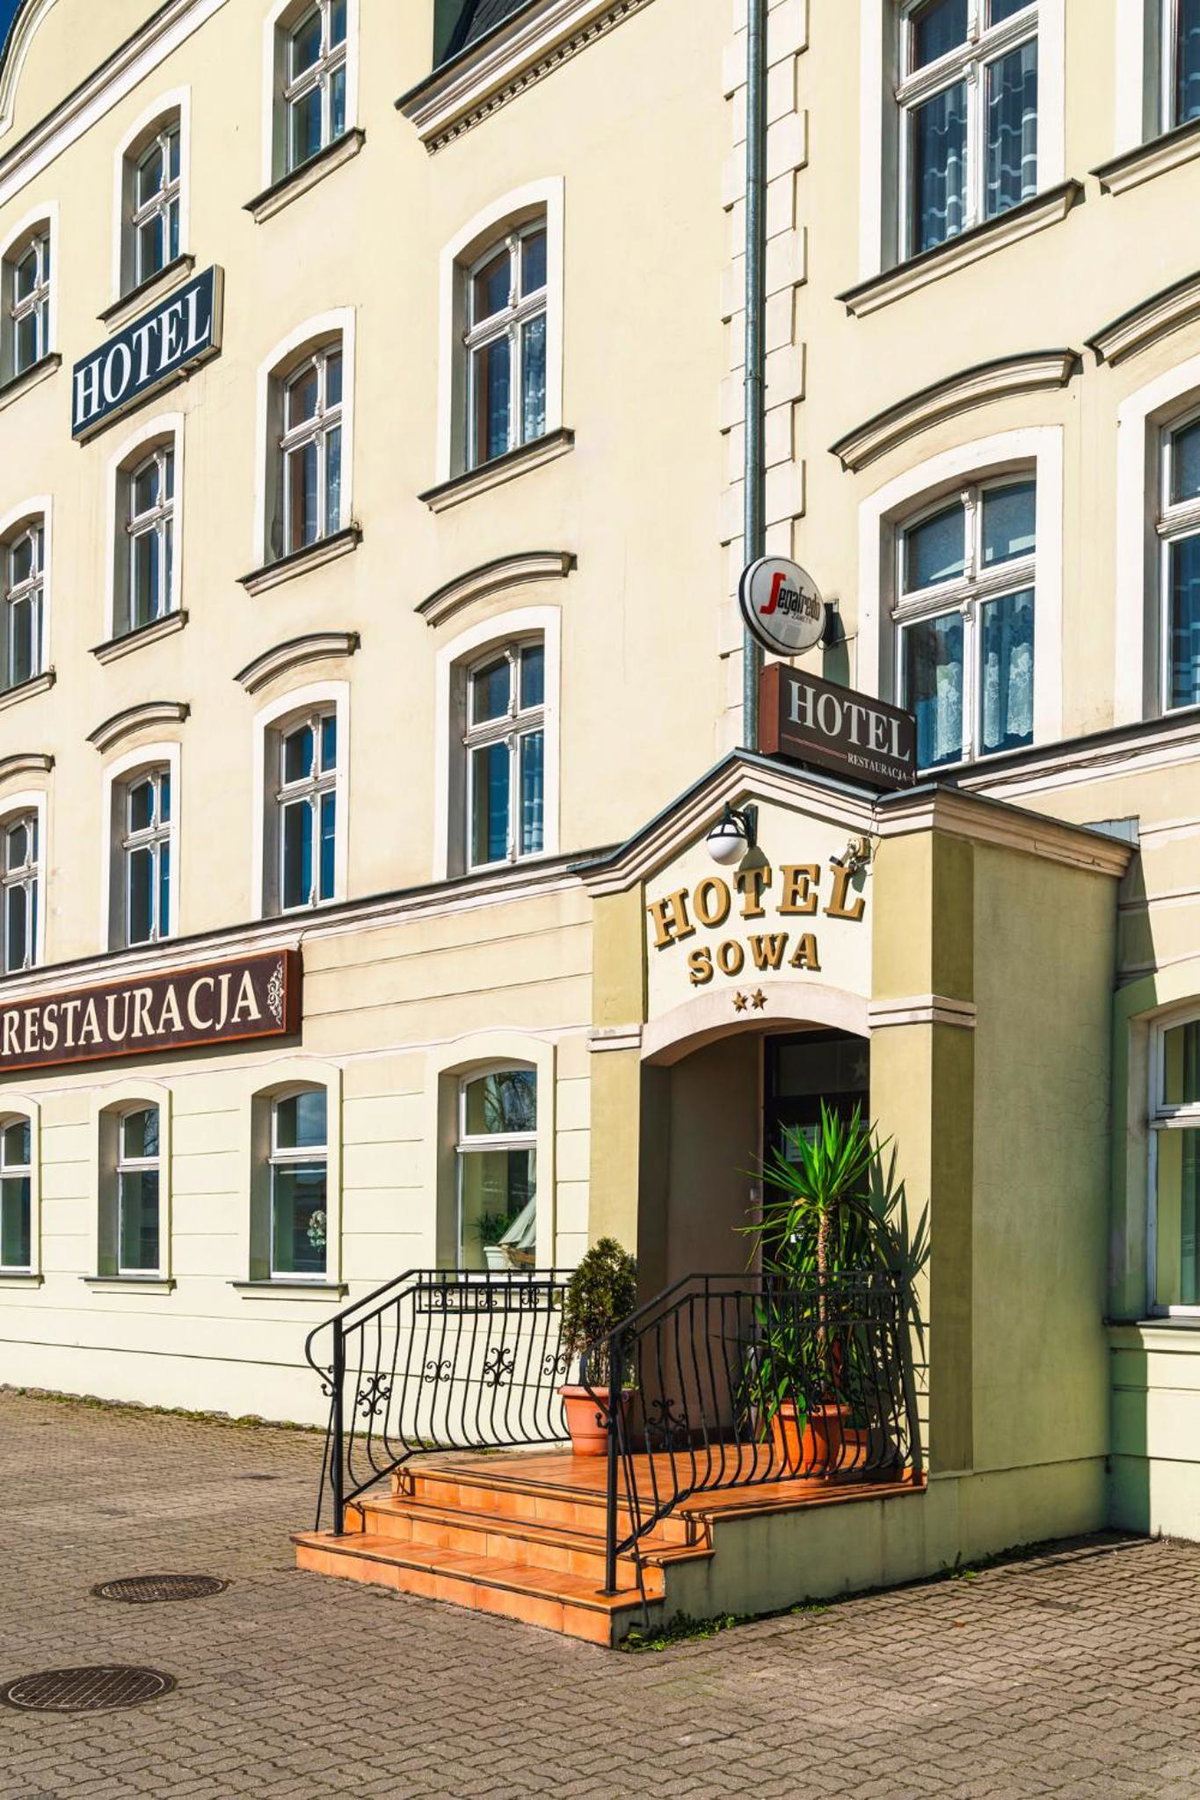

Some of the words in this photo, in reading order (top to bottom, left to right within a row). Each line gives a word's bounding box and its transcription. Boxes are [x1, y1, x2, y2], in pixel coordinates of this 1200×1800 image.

[73, 286, 211, 428] HOTEL
[759, 572, 820, 621] Segafredo
[788, 680, 911, 762] HOTEL
[847, 752, 907, 781] RESTAURACJA
[646, 864, 866, 948] HOTEL
[687, 932, 821, 985] SOWA
[1, 970, 262, 1056] RESTAURACJA
